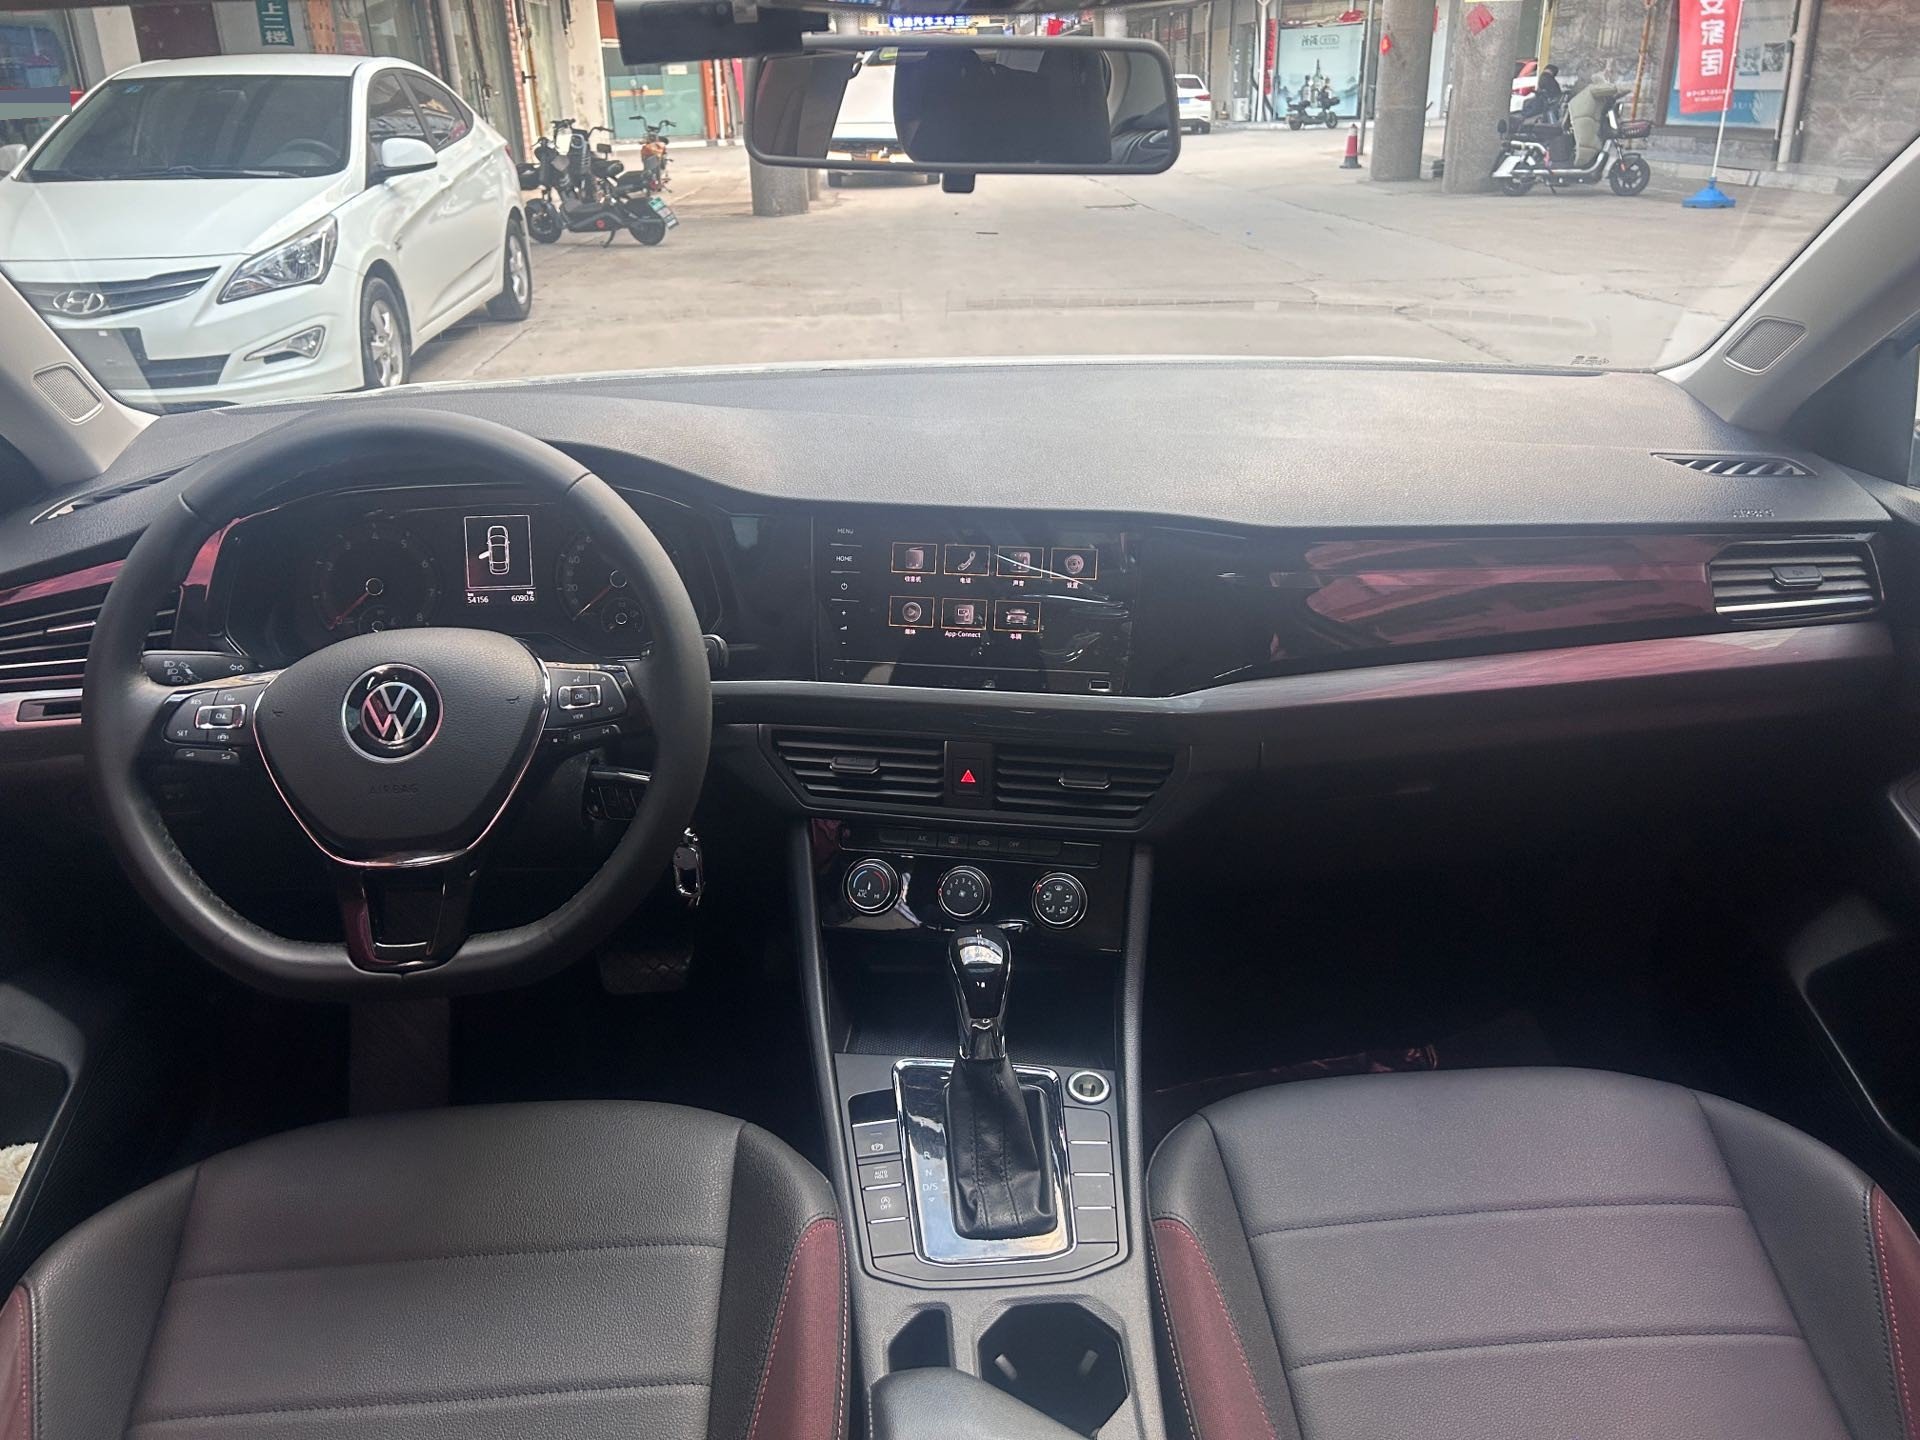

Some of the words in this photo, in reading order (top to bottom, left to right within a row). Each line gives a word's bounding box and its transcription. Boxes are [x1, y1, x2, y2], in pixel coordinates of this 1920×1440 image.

[261, 2, 289, 43] 上二楼
[467, 596, 489, 604] 54156
[574, 692, 584, 700] OK
[190, 697, 202, 705] RES
[924, 1151, 931, 1160] R
[925, 1169, 933, 1177] N
[922, 1183, 938, 1191] D/S
